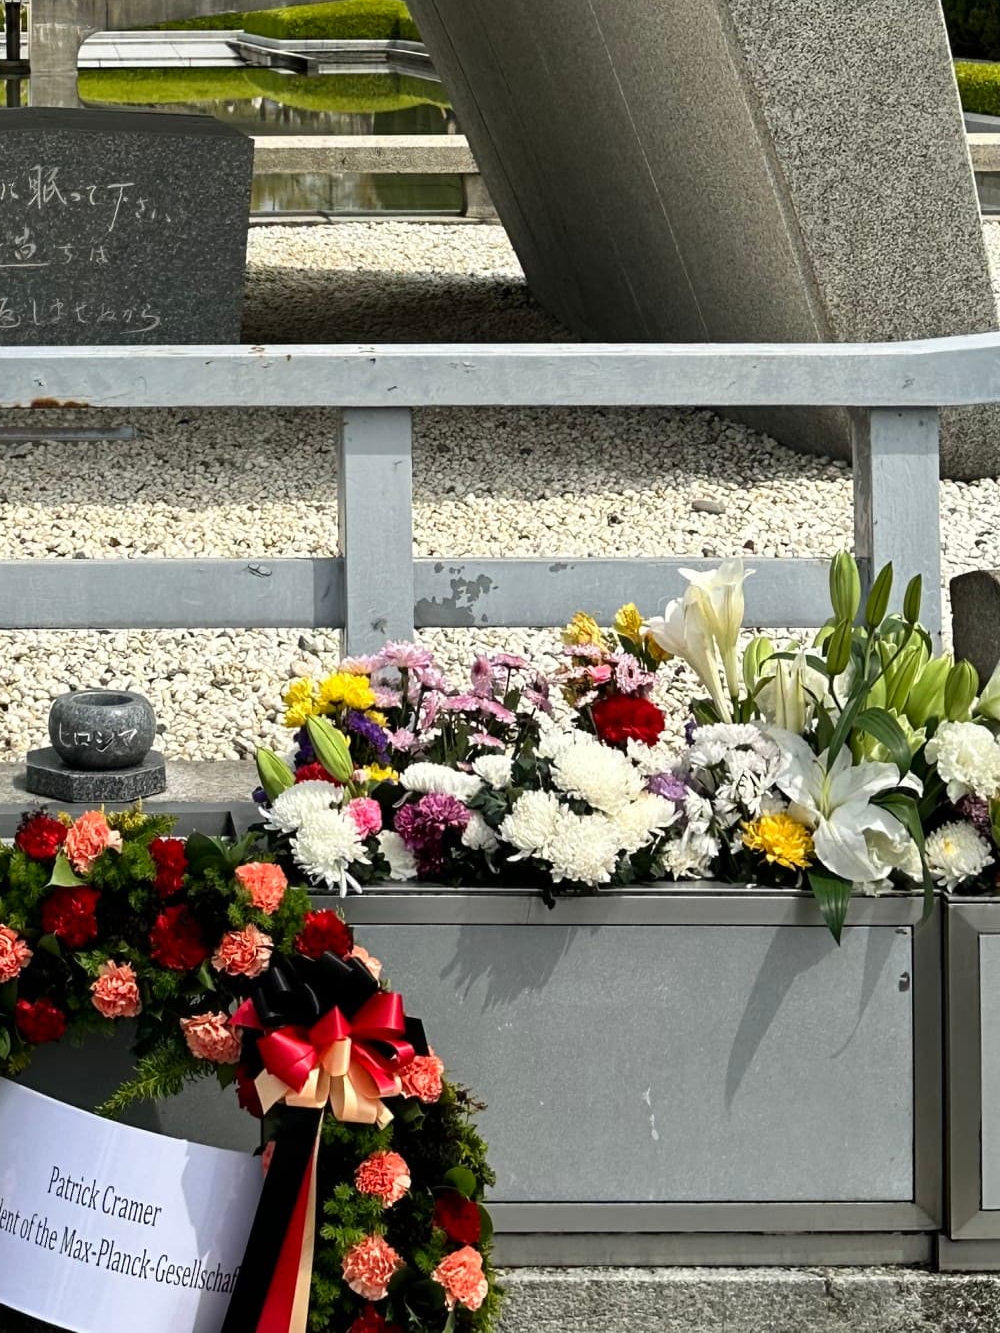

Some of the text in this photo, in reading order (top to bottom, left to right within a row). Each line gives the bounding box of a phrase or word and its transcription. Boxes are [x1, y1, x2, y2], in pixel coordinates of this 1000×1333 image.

[47, 1165, 162, 1227] Patrick Cramer
[20, 1213, 39, 1242] of
[35, 1217, 58, 1250] the
[60, 1226, 241, 1294] Max-Planck-Gesellschaf
